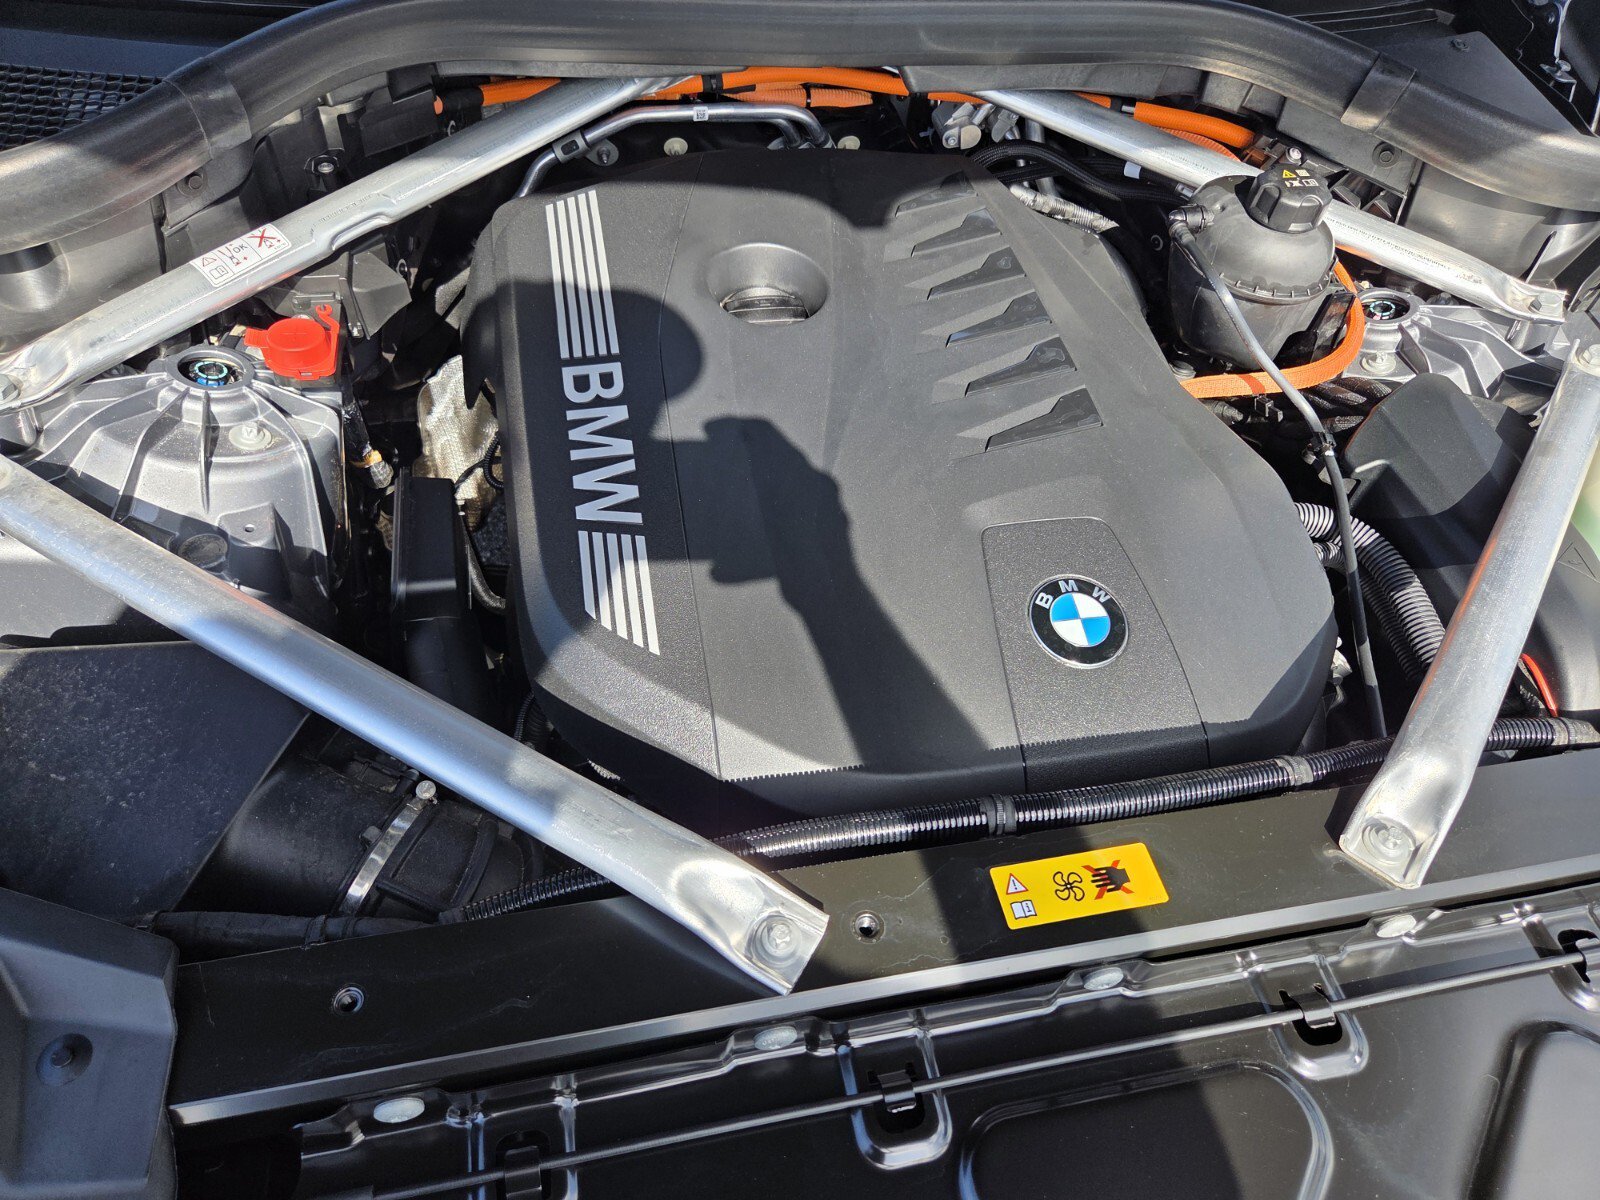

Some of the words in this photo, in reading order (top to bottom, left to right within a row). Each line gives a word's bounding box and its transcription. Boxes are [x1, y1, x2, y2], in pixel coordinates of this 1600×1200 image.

[232, 243, 248, 254] OK
[561, 361, 644, 525] BMW
[1035, 579, 1111, 610] BMW
